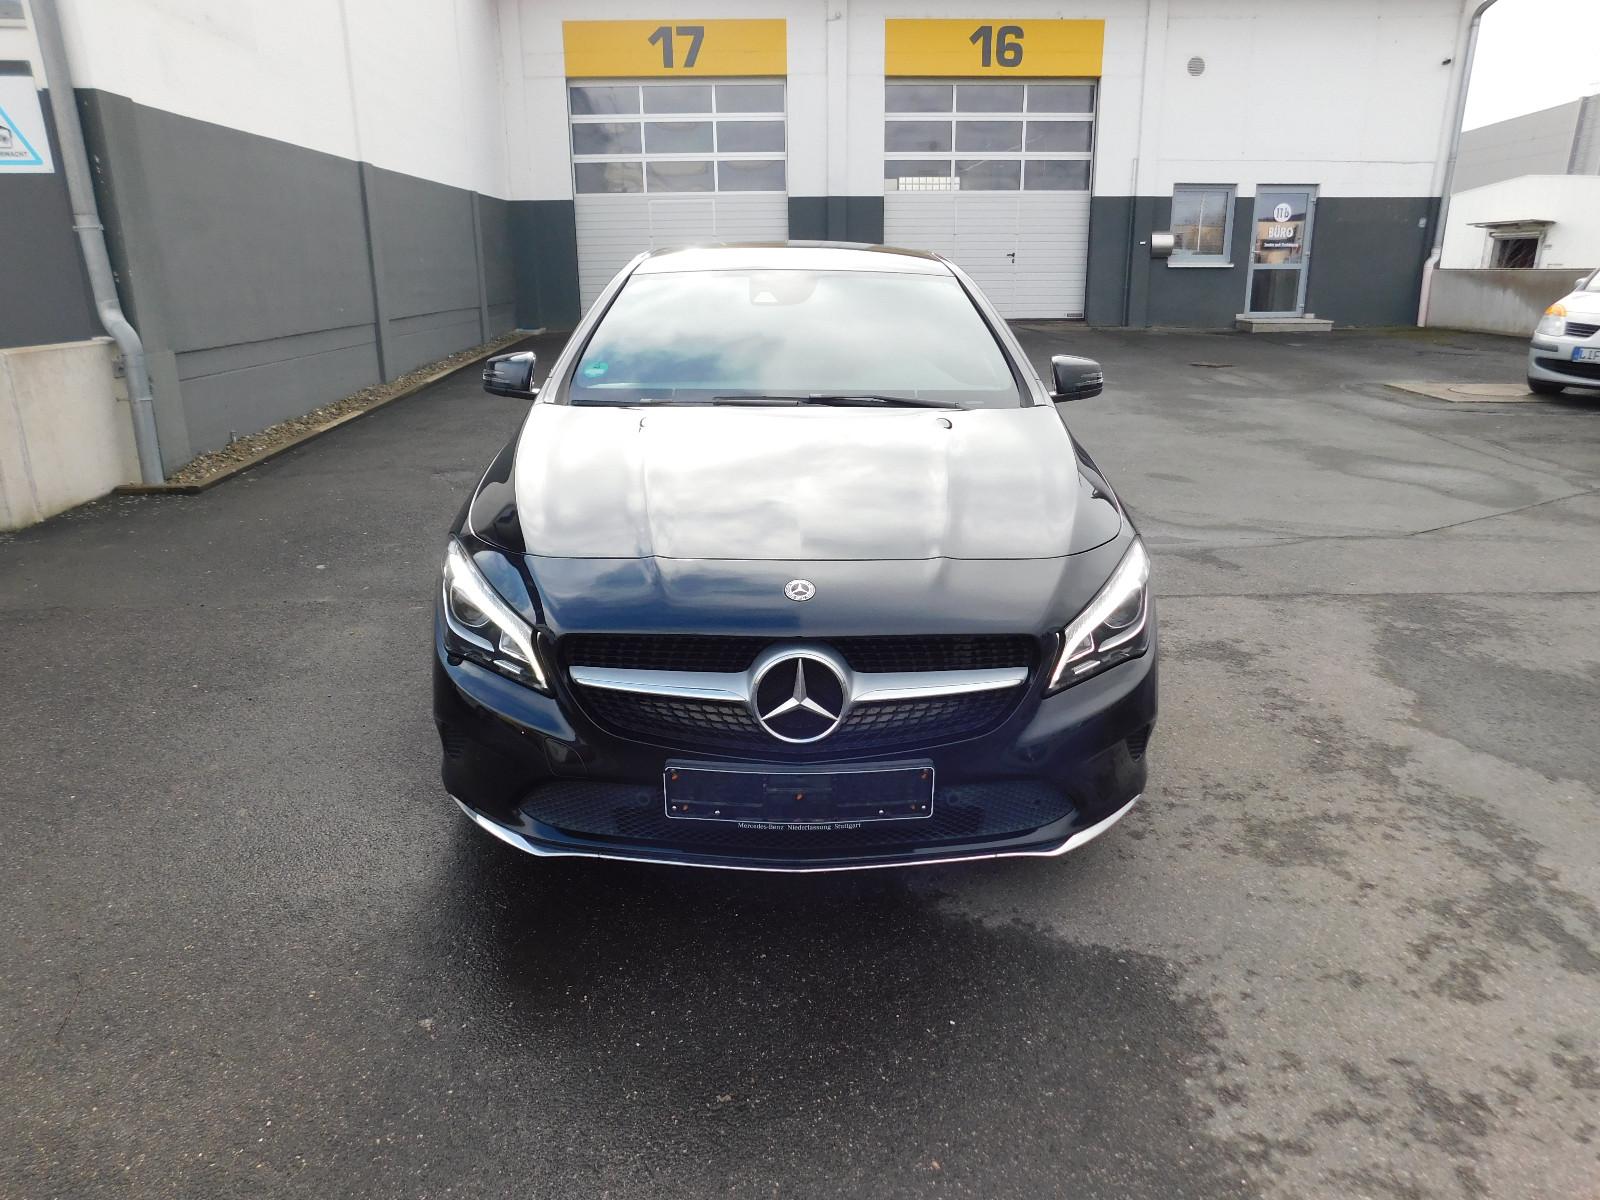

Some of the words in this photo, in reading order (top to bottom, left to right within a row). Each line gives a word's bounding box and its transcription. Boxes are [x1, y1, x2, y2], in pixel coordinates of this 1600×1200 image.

[647, 25, 705, 69] 17
[969, 25, 1025, 68] 16
[1268, 225, 1294, 238] BÜRO
[737, 822, 784, 830] Mercedes-Benz
[834, 822, 861, 830] Stuttgart
